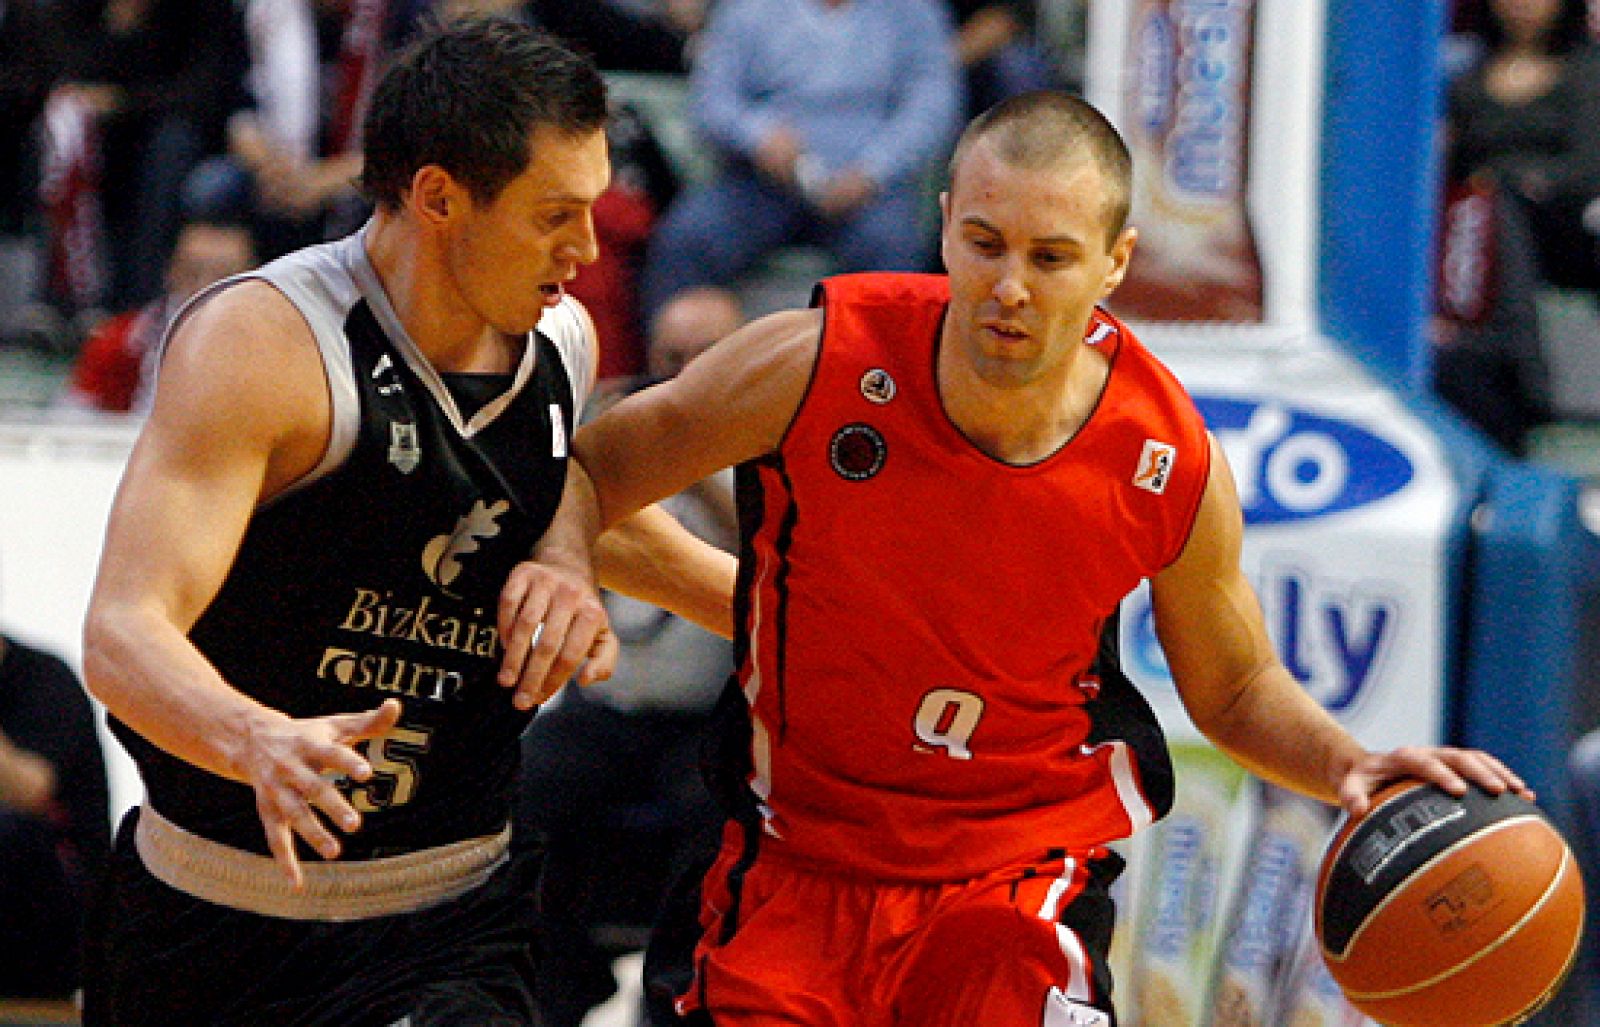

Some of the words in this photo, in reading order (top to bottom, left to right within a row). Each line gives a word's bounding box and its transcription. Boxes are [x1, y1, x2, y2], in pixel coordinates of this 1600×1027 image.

[336, 586, 498, 658] Bizkaia
[1276, 575, 1390, 712] ly
[345, 726, 432, 812] 5
